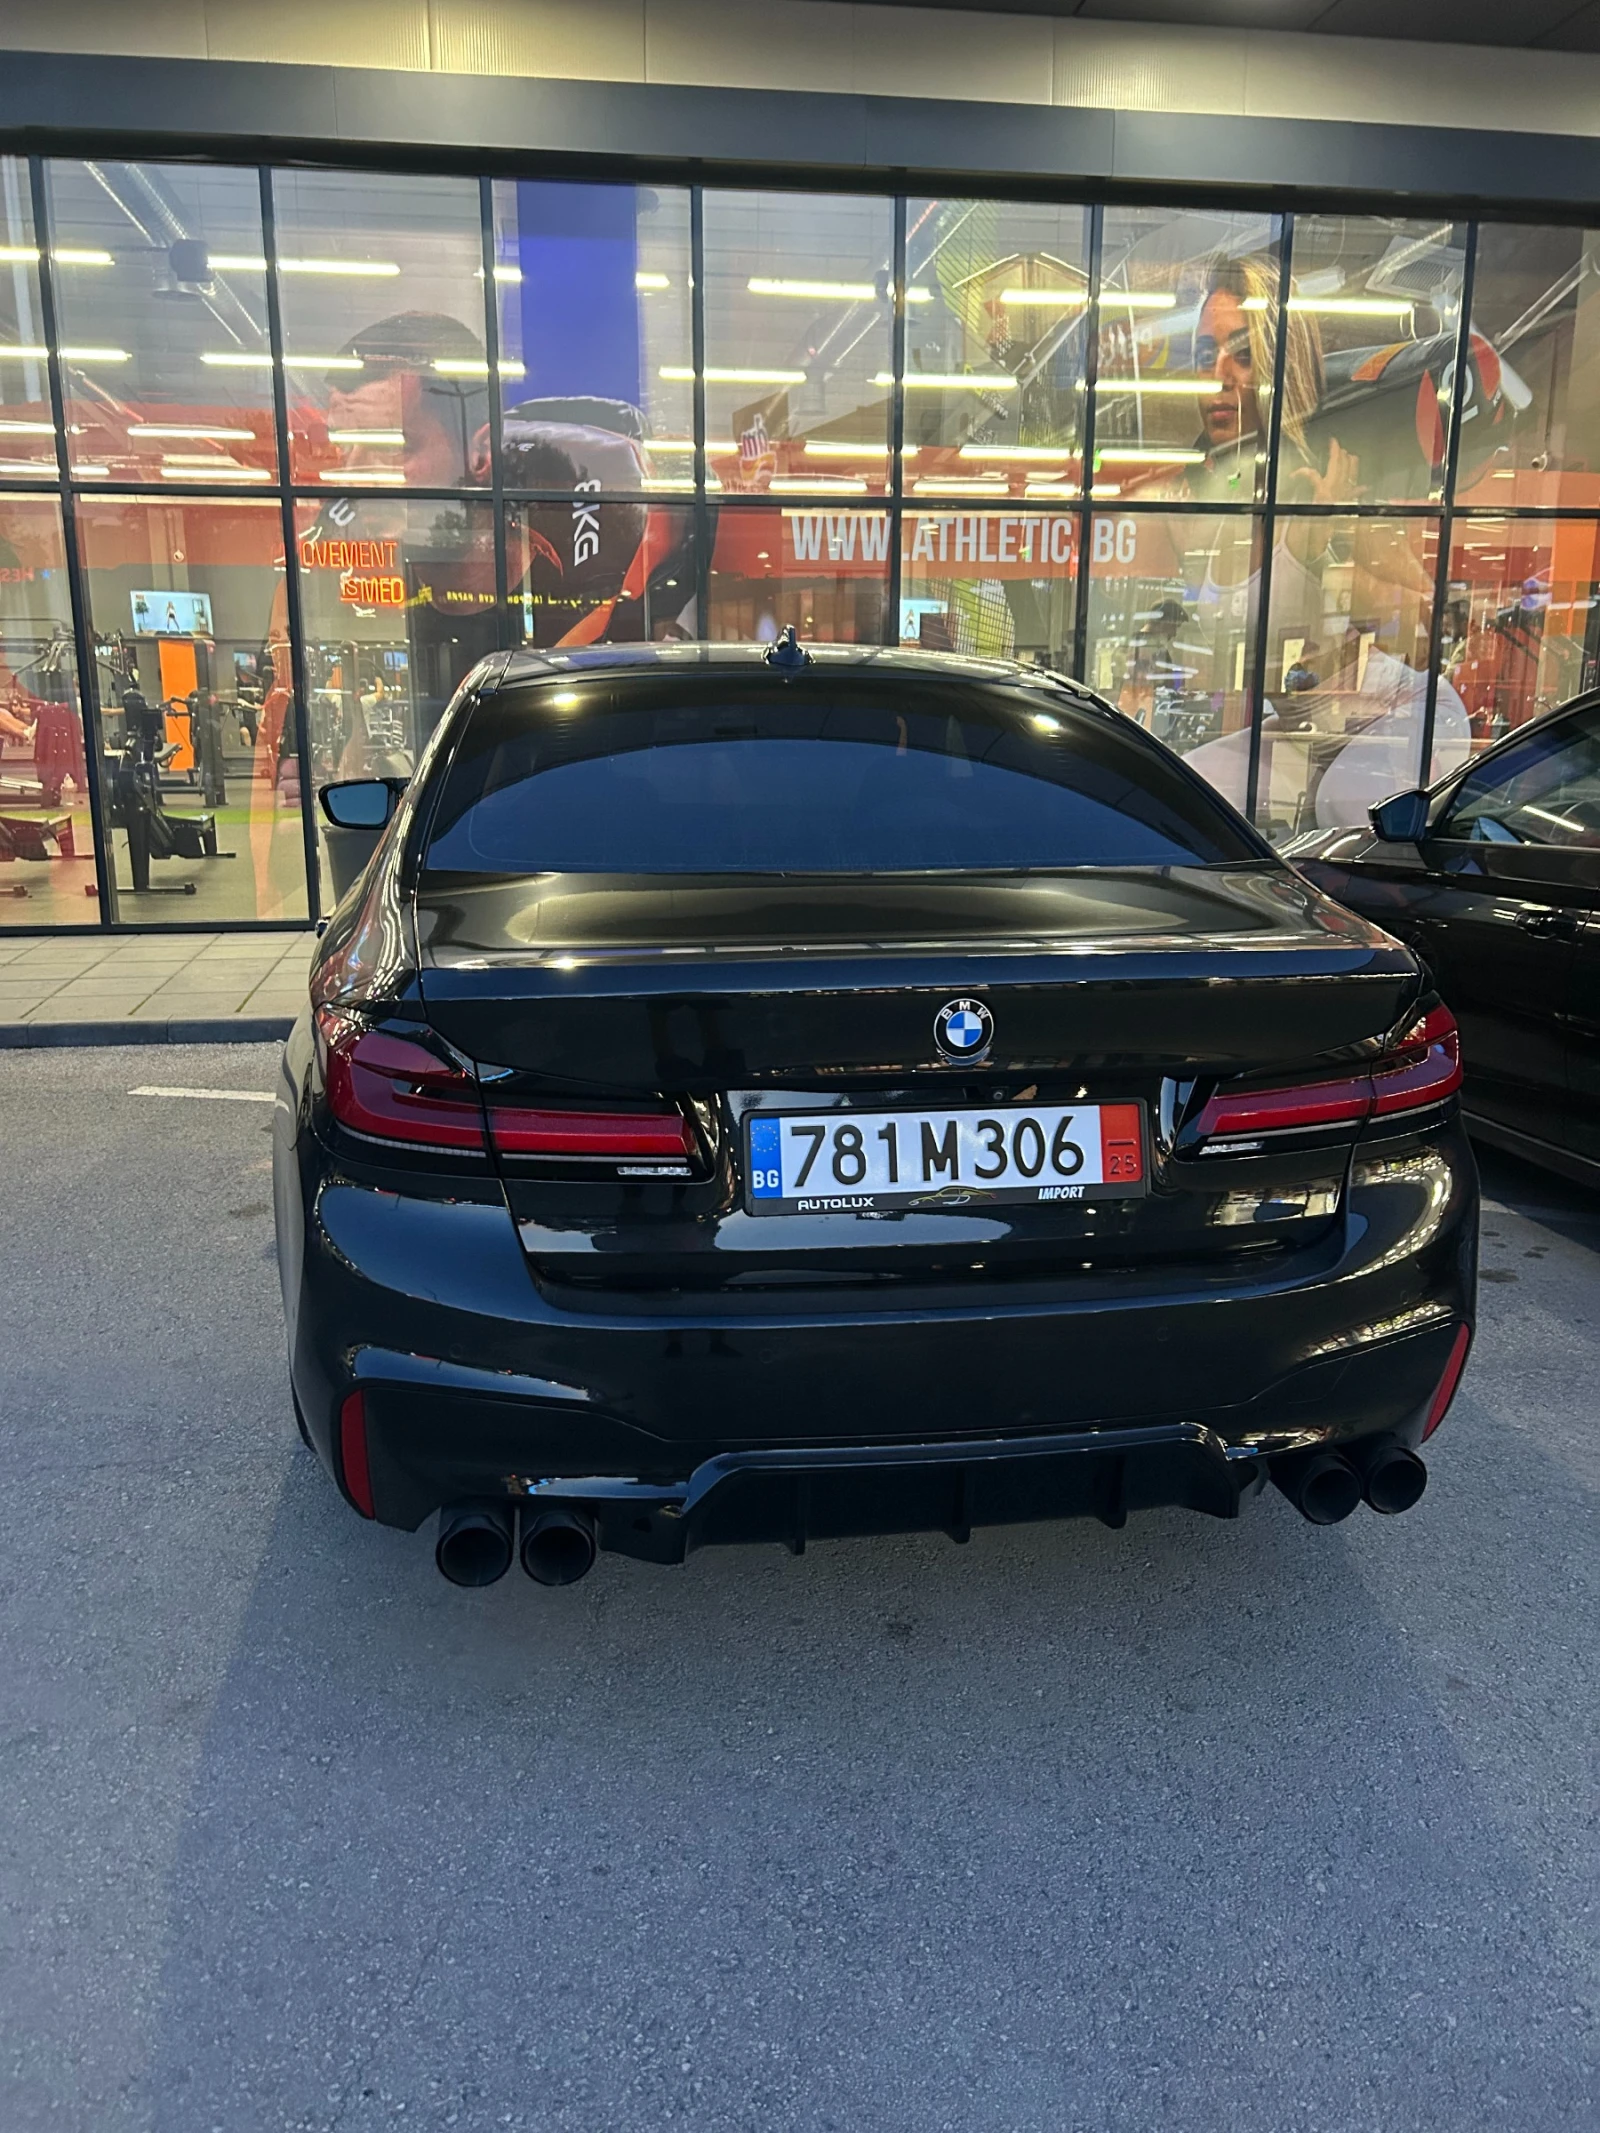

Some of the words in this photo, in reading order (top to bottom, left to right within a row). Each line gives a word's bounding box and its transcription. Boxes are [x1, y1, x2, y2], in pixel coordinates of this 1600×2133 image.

[940, 1001, 990, 1020] BMW
[753, 1169, 779, 1189] BG
[791, 1122, 899, 1188] 781
[920, 1120, 960, 1182] M
[975, 1116, 1085, 1179] 306
[1109, 1153, 1137, 1174] 25
[797, 1197, 874, 1211] AUTOLUX
[1038, 1186, 1085, 1200] IMPORT
